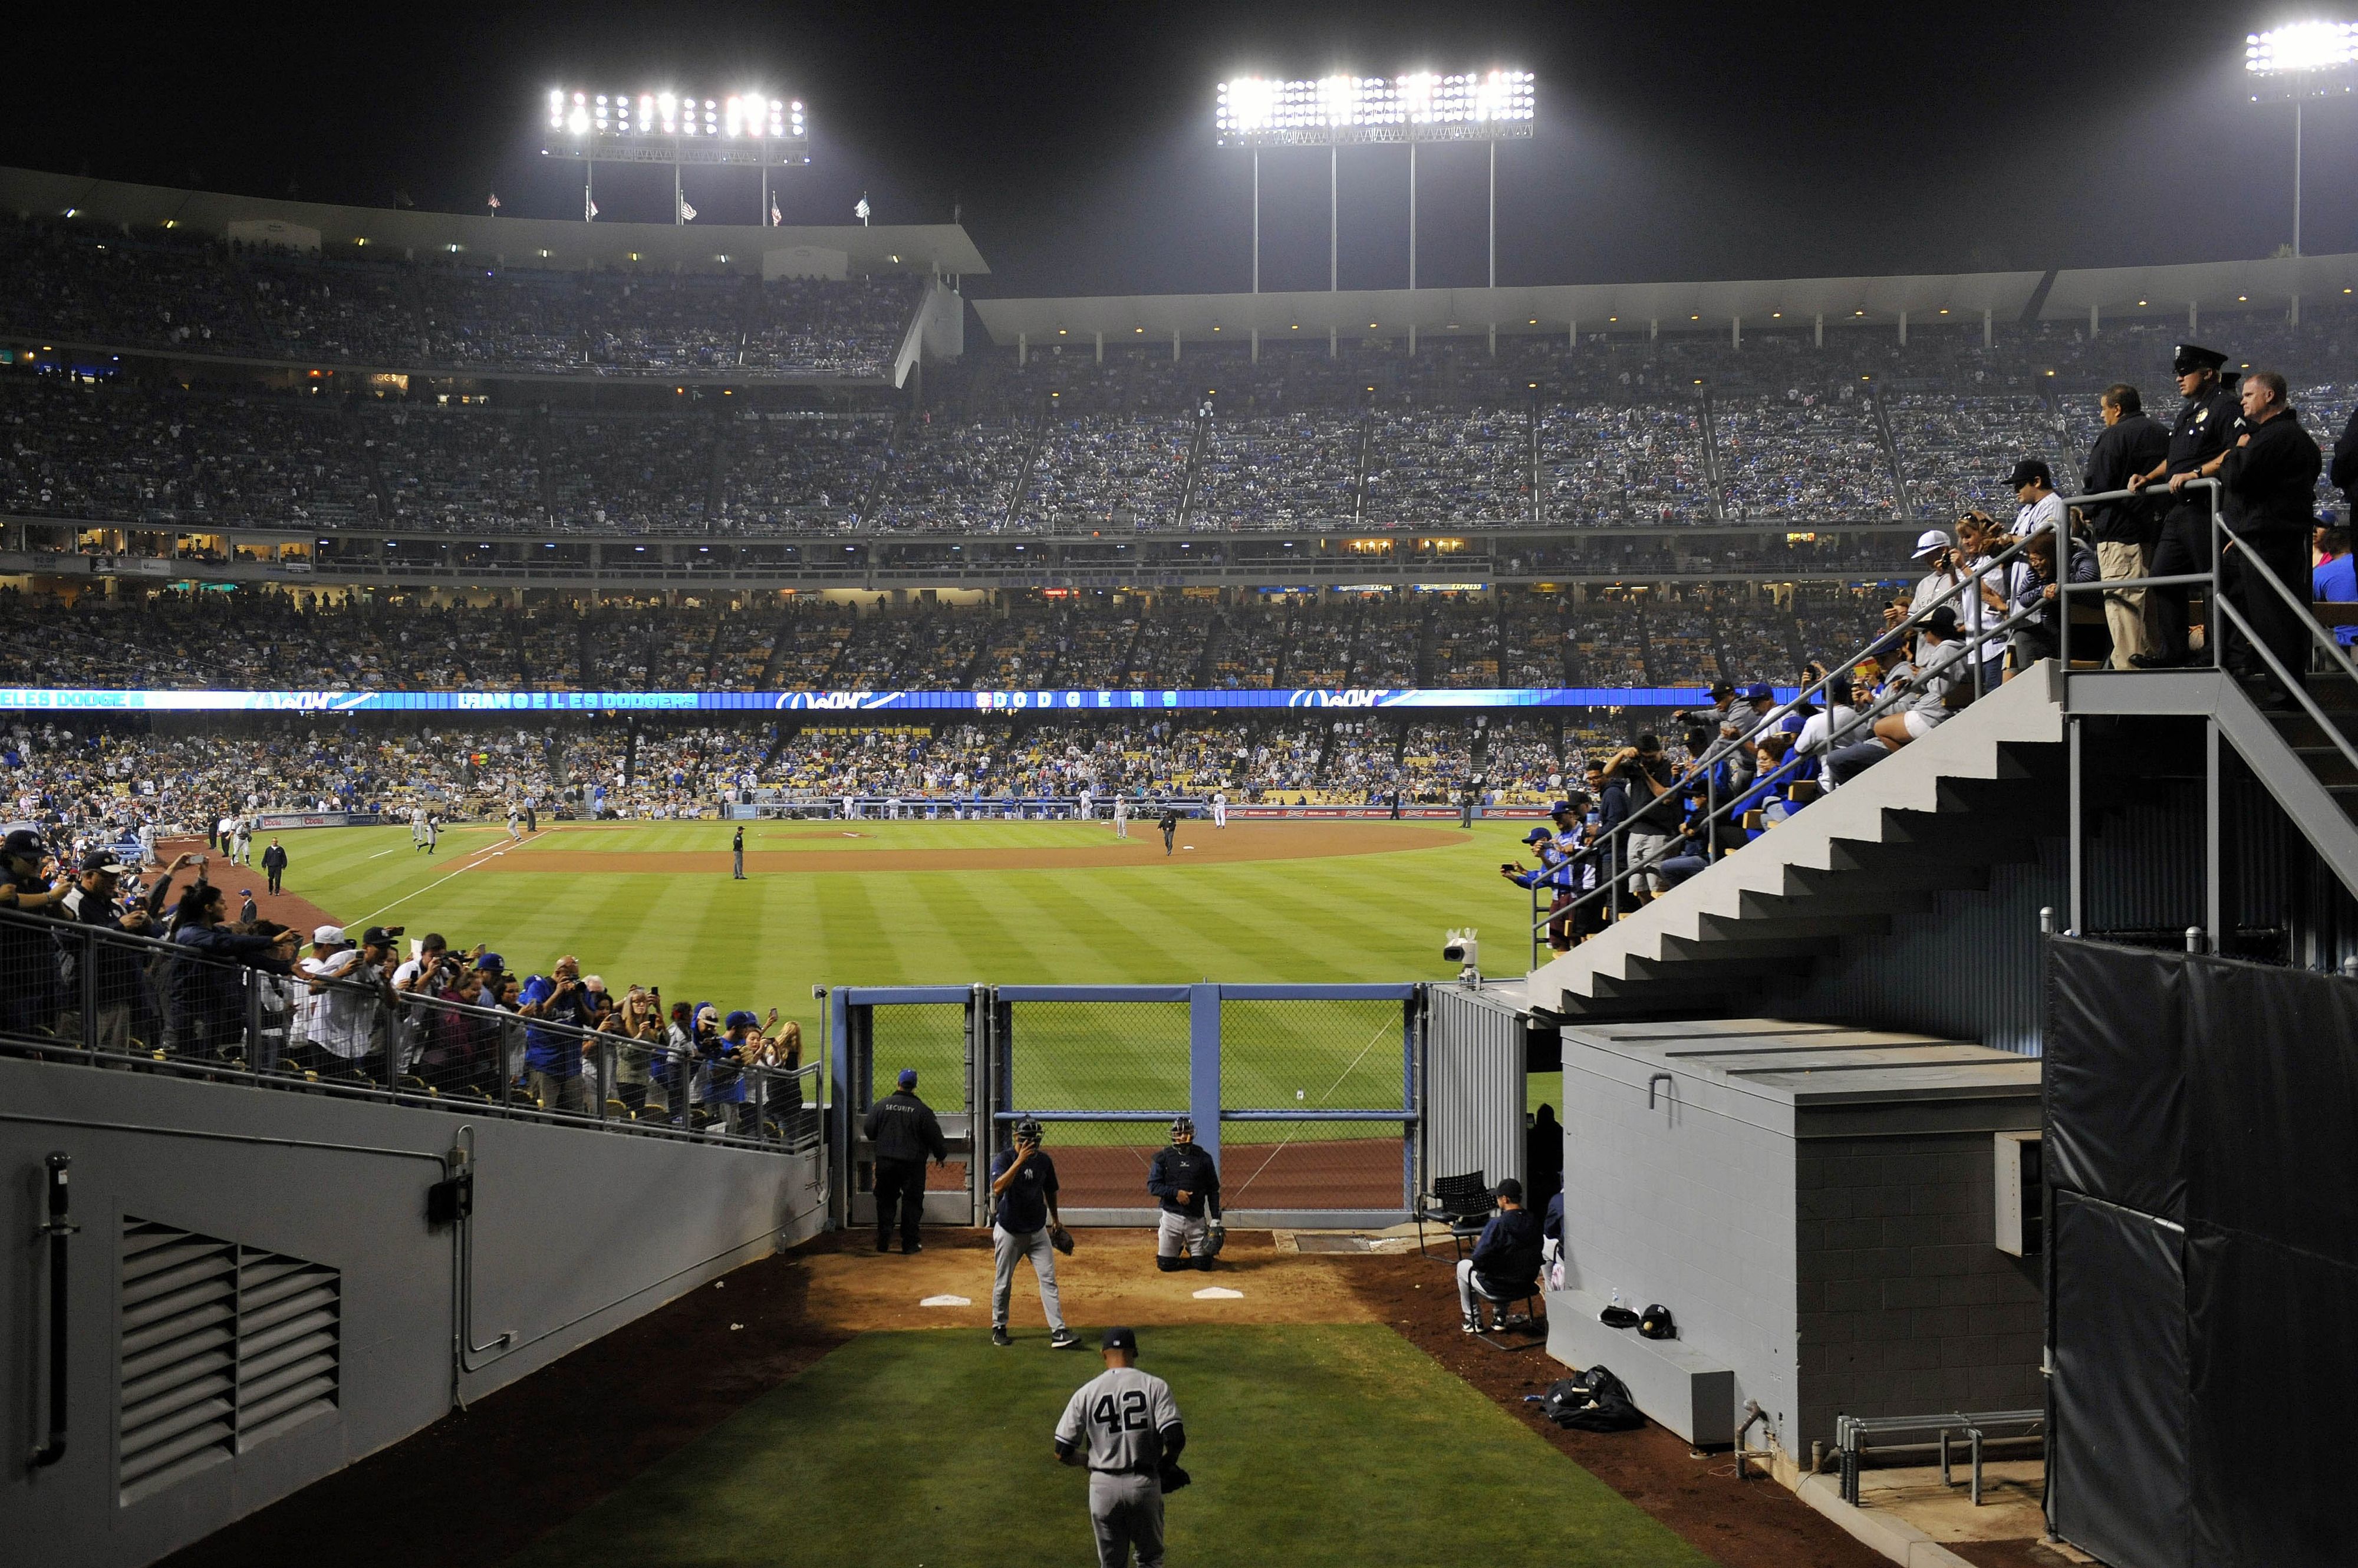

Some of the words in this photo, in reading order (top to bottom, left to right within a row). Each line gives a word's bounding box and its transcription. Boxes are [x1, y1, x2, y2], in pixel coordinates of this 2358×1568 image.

[602, 693, 699, 708] DODGERS
[264, 816, 282, 826] Coors
[304, 816, 324, 825] Coors
[885, 1103, 915, 1114] SECURITY
[1094, 1390, 1148, 1434] 42
